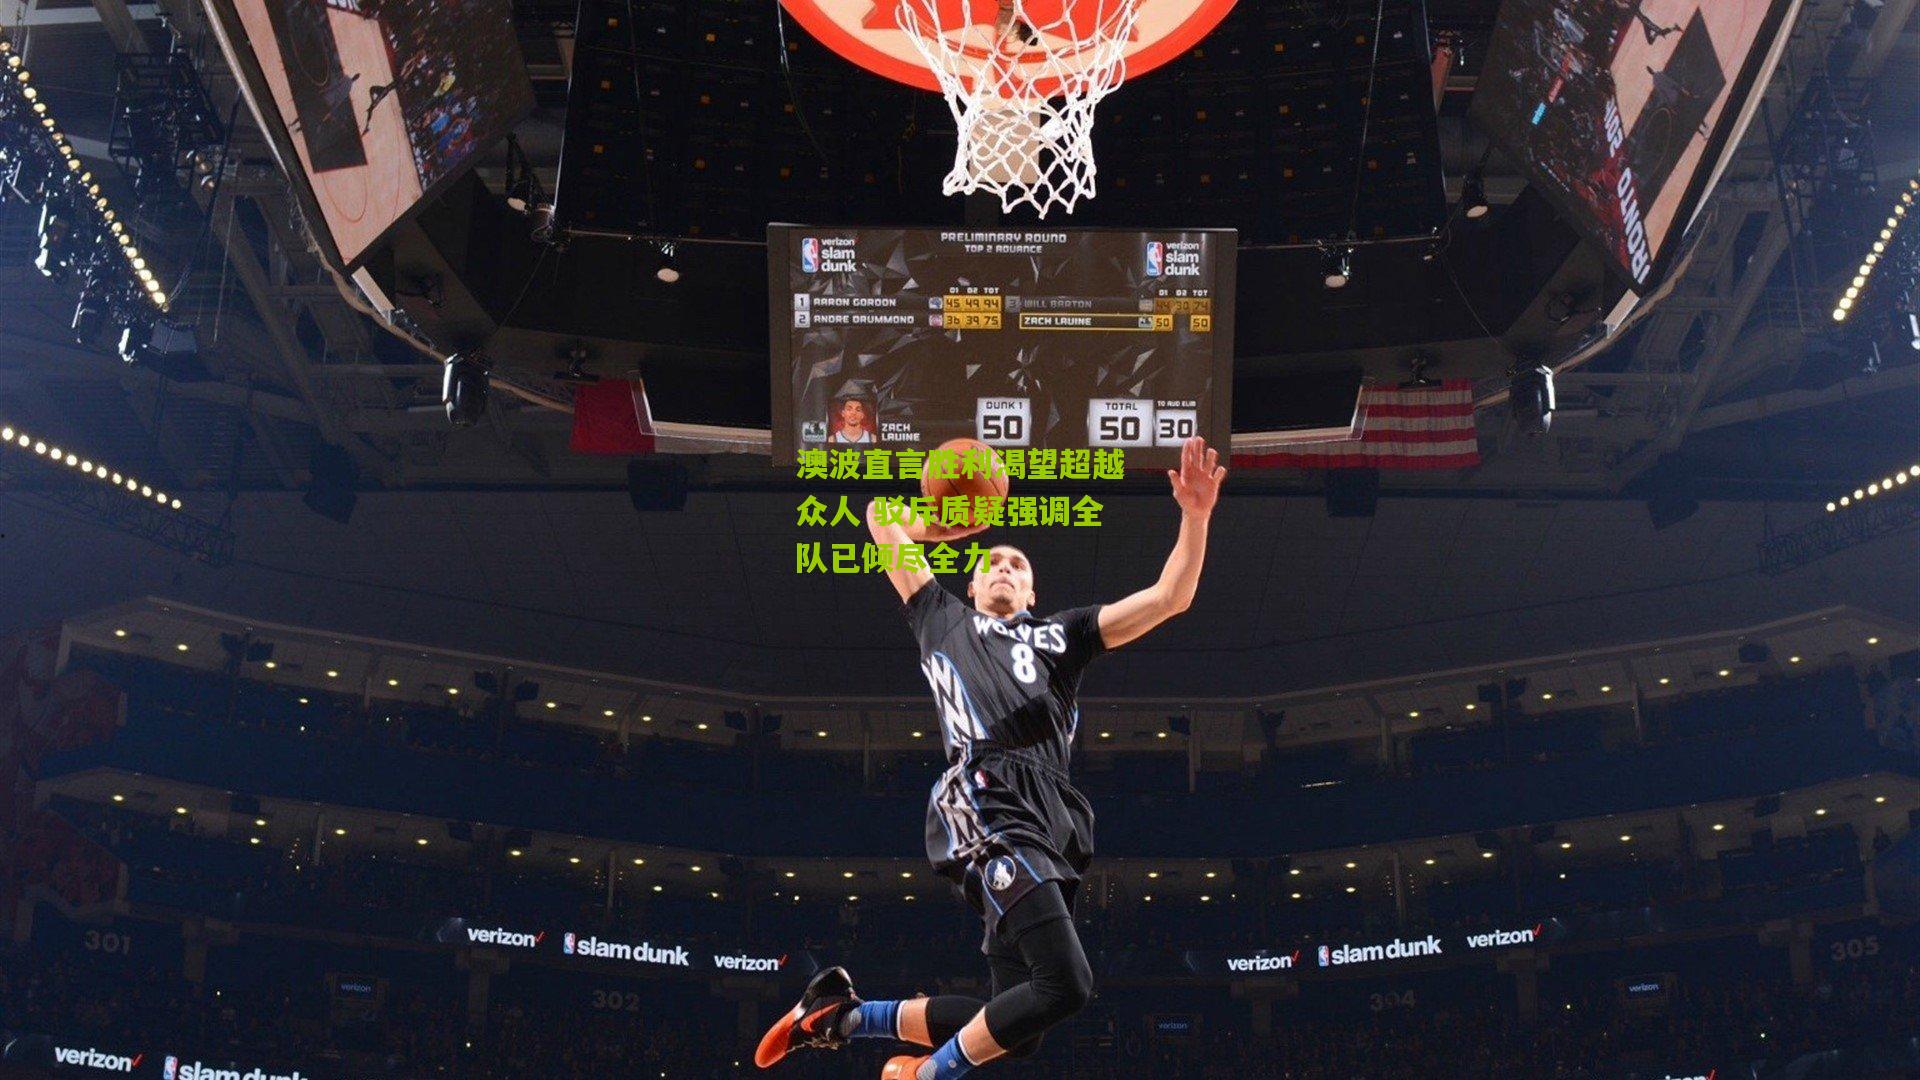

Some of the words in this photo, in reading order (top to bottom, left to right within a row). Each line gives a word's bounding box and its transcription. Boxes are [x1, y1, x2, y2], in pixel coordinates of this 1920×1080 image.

[821, 237, 855, 246] verizon
[941, 232, 1021, 242] PRELIMINARY
[1025, 233, 1067, 243] ROUND
[965, 245, 985, 254] TOP
[986, 245, 993, 253] 2
[996, 245, 1043, 254] ADVANCE
[1166, 242, 1199, 250] verizon
[821, 247, 856, 260] slam
[1165, 251, 1199, 263] slam
[821, 260, 857, 272] dunk
[1165, 263, 1200, 276] dunk
[799, 297, 805, 307] 1
[813, 298, 850, 307] AARON
[853, 299, 897, 307] GORDON
[946, 299, 960, 308] 45
[965, 299, 980, 308] 49
[984, 299, 999, 308] 94
[1024, 299, 1047, 308] WILL
[1050, 300, 1092, 309] BARTON
[799, 314, 806, 324] 2
[813, 315, 850, 324] ANDRE
[853, 316, 915, 324] DRUMMOND
[966, 316, 980, 325] 39
[984, 316, 999, 326] 75
[1024, 316, 1052, 325] ZACH
[1054, 317, 1092, 326] LAVINE
[1156, 318, 1170, 327] 50
[1193, 318, 1208, 327] 50
[985, 401, 1015, 410] DUNK
[1018, 402, 1023, 410] 1
[1105, 402, 1138, 411] TOTAL
[881, 423, 911, 432] ZACH
[983, 415, 1023, 439] 50
[1100, 416, 1140, 440] 50
[1160, 418, 1193, 438] 30
[881, 433, 920, 441] LAVINE
[1011, 643, 1037, 684] 8
[84, 930, 131, 955] 301
[467, 928, 535, 948] verizon
[1467, 928, 1534, 948] verizon
[577, 937, 631, 960] slam
[634, 942, 689, 966] dunk
[1332, 944, 1383, 965] slam
[1386, 935, 1442, 959] dunk
[1831, 935, 1879, 961] 305
[714, 954, 779, 971] verizon
[1227, 953, 1292, 971] verizon
[341, 983, 371, 993] verizon
[1629, 983, 1659, 992] verizon
[592, 989, 639, 1011] 302
[1158, 1020, 1187, 1030] verizon
[55, 1047, 132, 1072] verizon
[179, 1061, 240, 1080] slam
